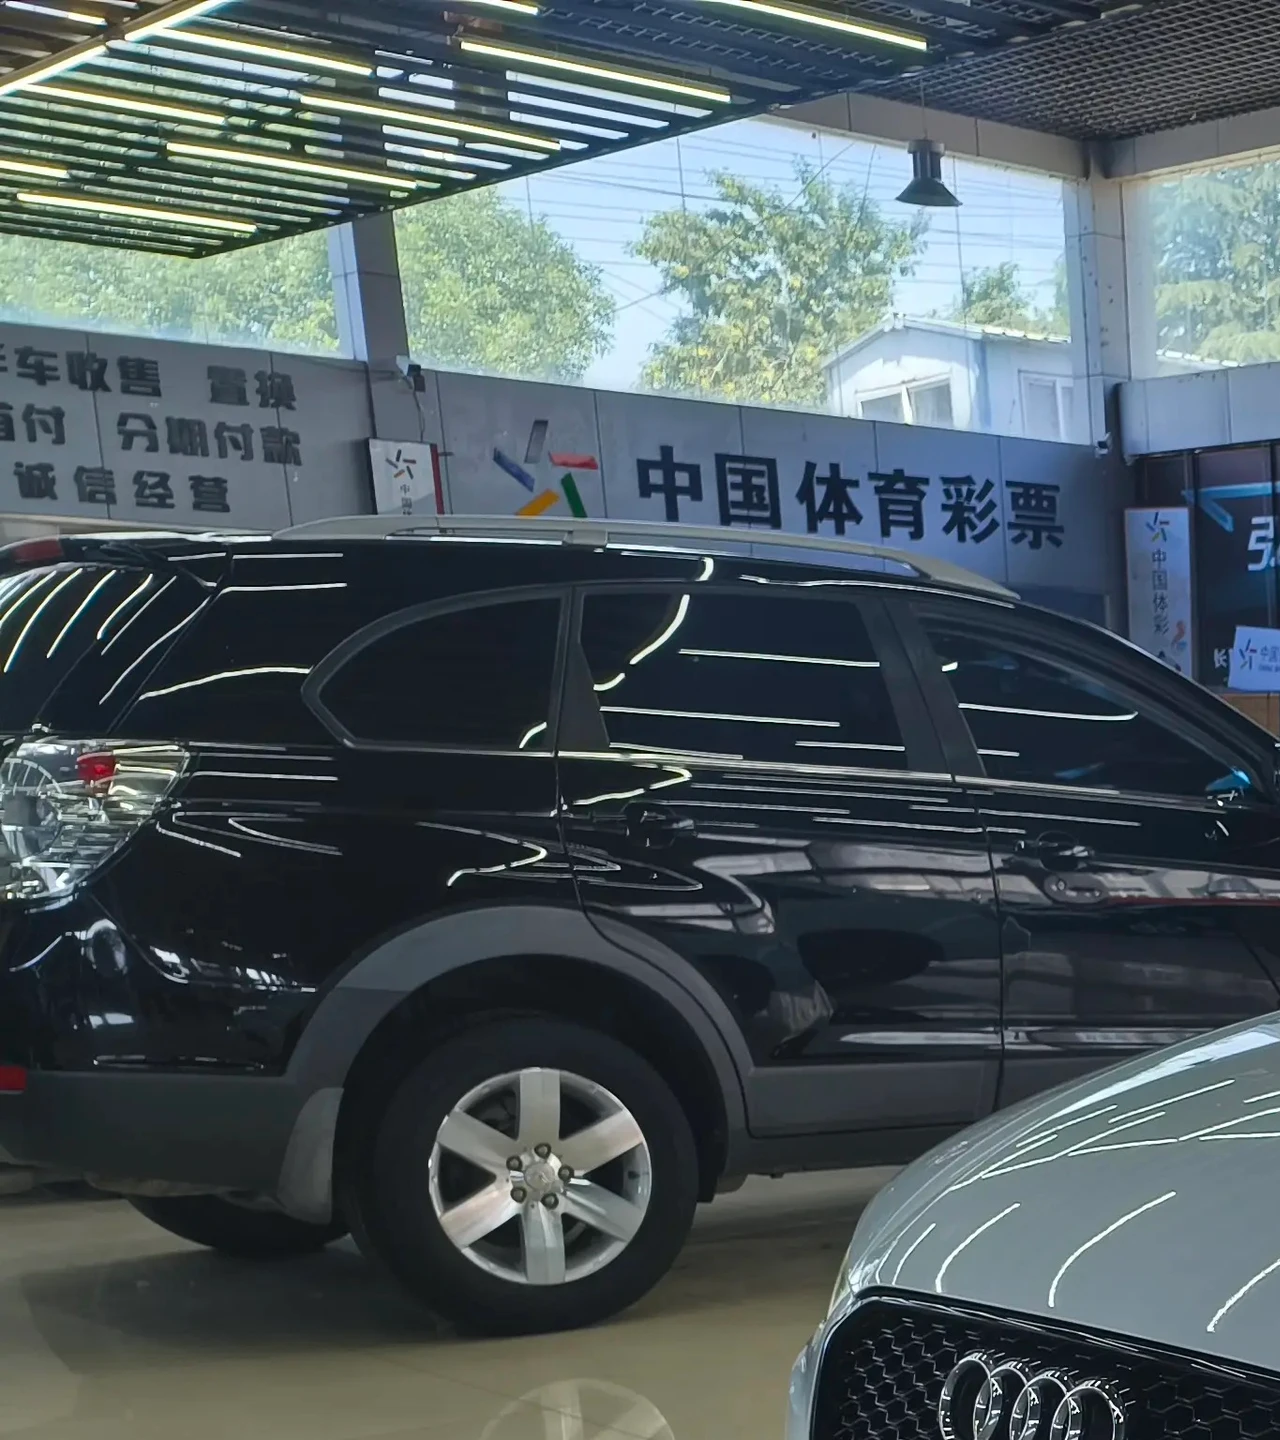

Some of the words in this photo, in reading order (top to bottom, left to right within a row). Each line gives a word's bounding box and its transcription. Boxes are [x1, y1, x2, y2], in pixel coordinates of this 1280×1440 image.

[0, 343, 162, 397] 车收售
[14, 461, 230, 513] 诚信经营
[636, 444, 1065, 550] 中国体育彩票
[1151, 549, 1169, 636] 中国体彩
